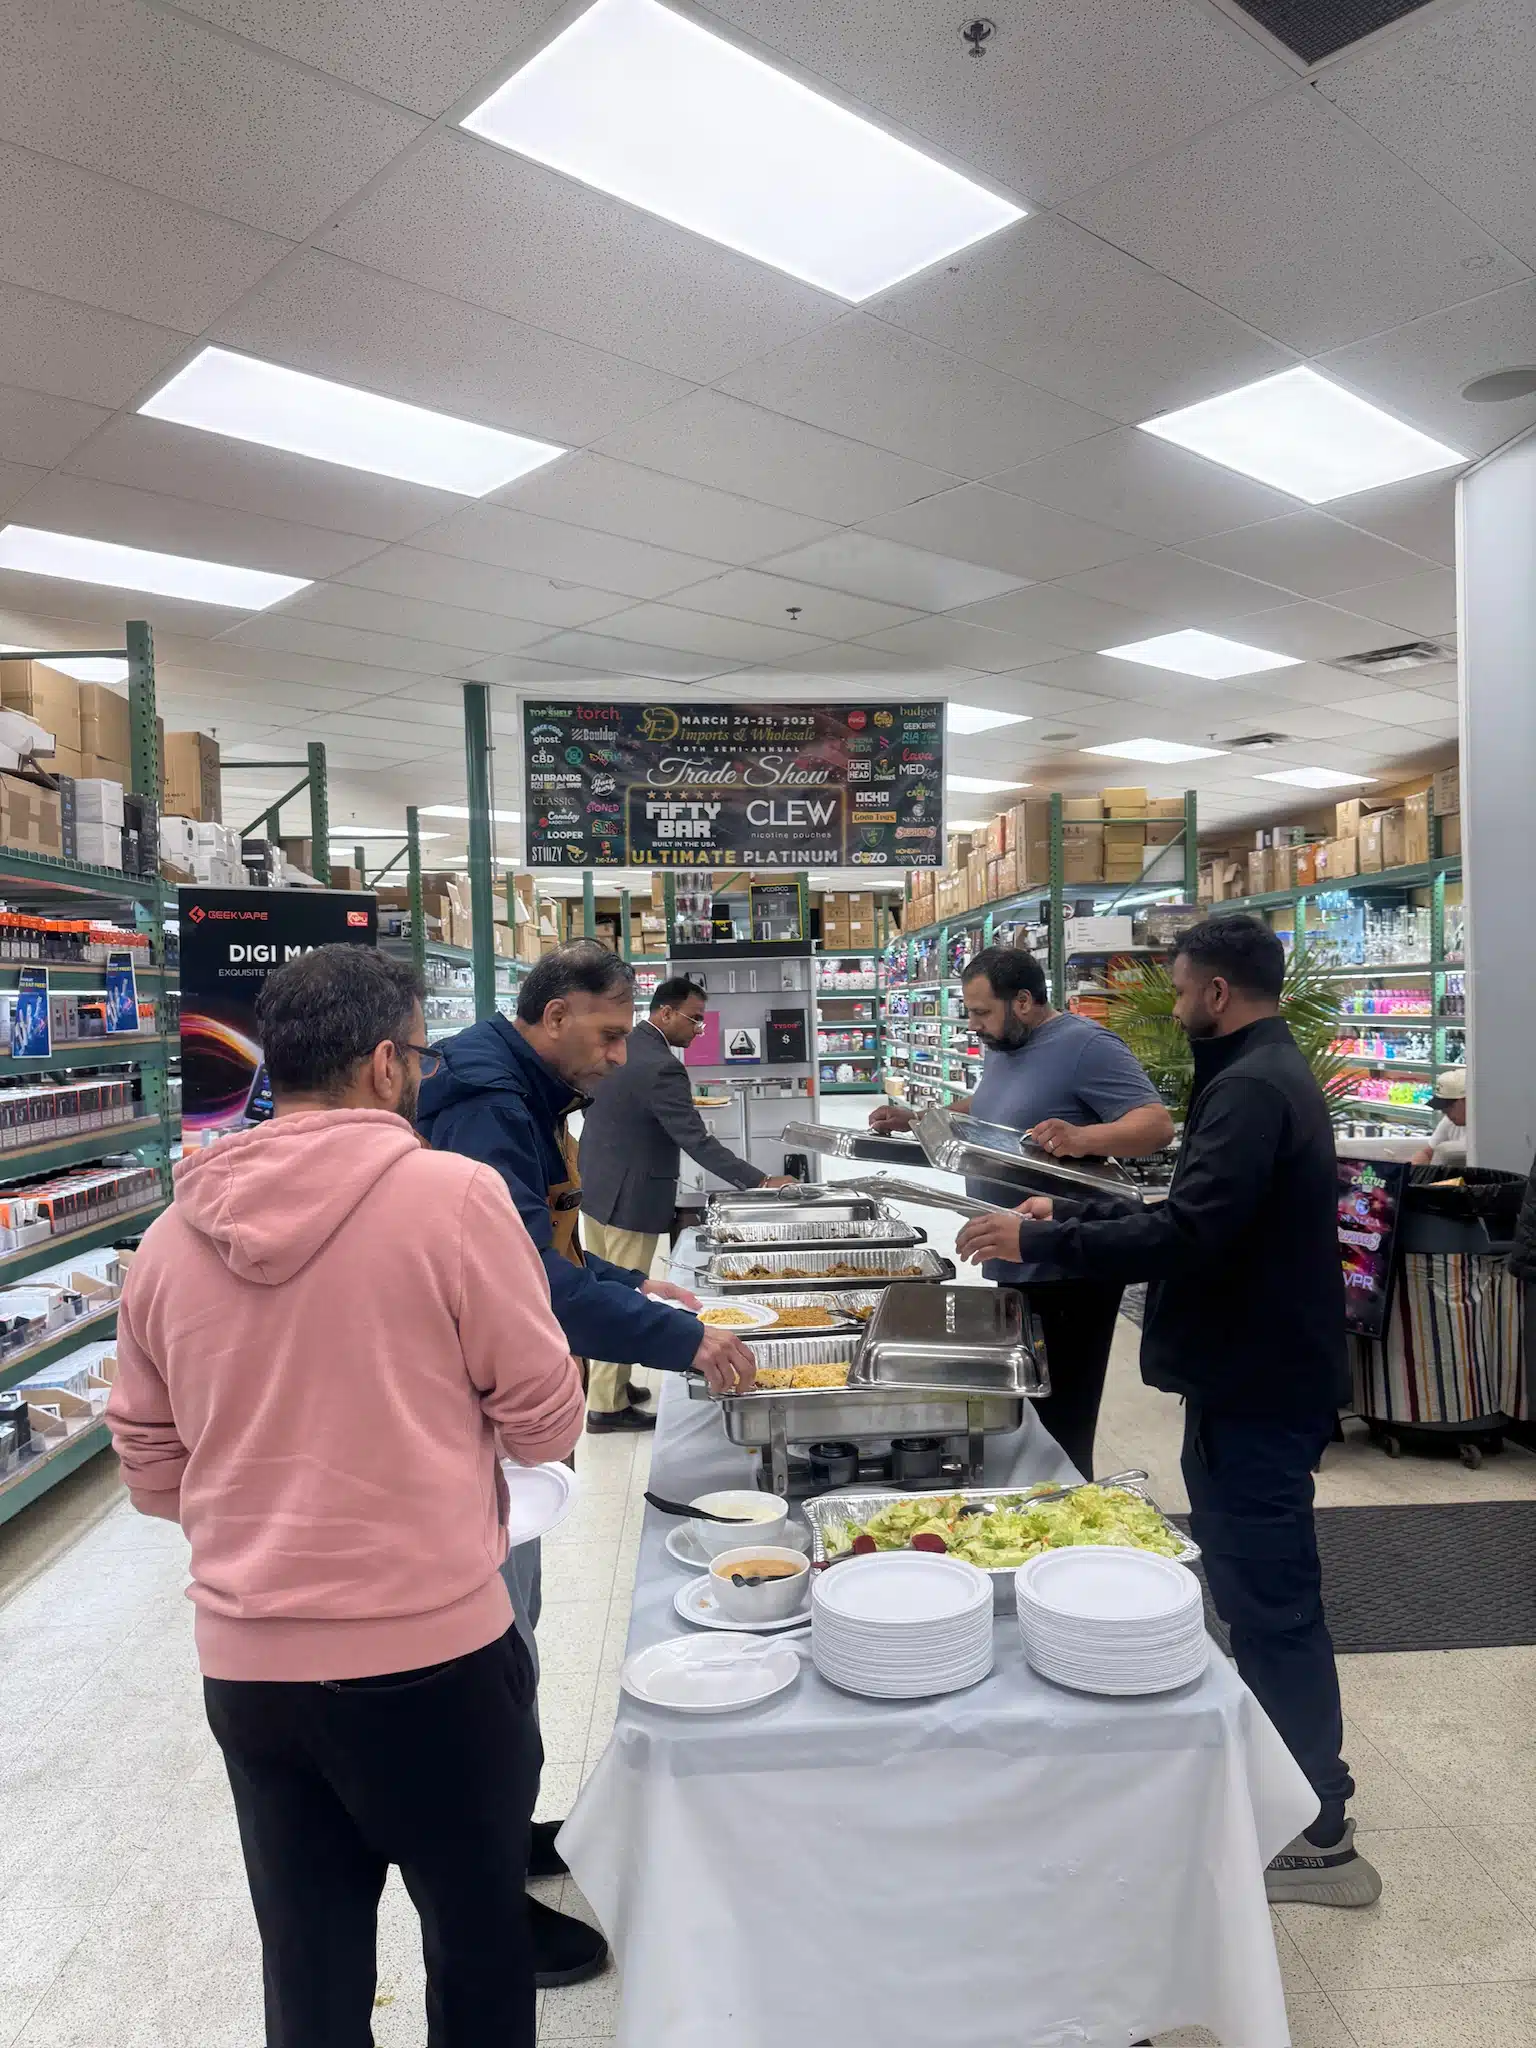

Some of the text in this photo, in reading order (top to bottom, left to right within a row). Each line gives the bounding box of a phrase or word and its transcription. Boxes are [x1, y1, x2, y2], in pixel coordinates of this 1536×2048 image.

[577, 705, 620, 721] torch
[681, 716, 815, 727] MARCH 24-25, 2025
[583, 725, 618, 741] Boulder
[733, 728, 747, 742] &
[751, 727, 816, 742] Wholesale
[531, 754, 554, 763] CBD
[647, 757, 737, 787] Trade
[743, 755, 830, 787] Show
[850, 771, 870, 779] HEAD
[899, 763, 924, 775] MED
[543, 774, 582, 782] BRANDS
[855, 791, 890, 803] OCHO
[906, 789, 934, 798] CACTUS
[533, 796, 576, 806] CLASSIC
[586, 800, 619, 813] STONED
[746, 800, 837, 826] CLEW
[657, 820, 711, 838] BAR
[547, 831, 583, 840] LOOPER
[751, 831, 832, 841] nicotine pouches
[631, 850, 838, 864] ULTIMATE PLATINUM
[910, 854, 937, 865] VPR
[229, 944, 277, 963] DIGI
[218, 968, 265, 977] EXQUISITE
[1350, 1175, 1387, 1189] CACTUS
[1342, 1271, 1374, 1291] VPR
[1269, 1856, 1325, 1869] SPLY-350
